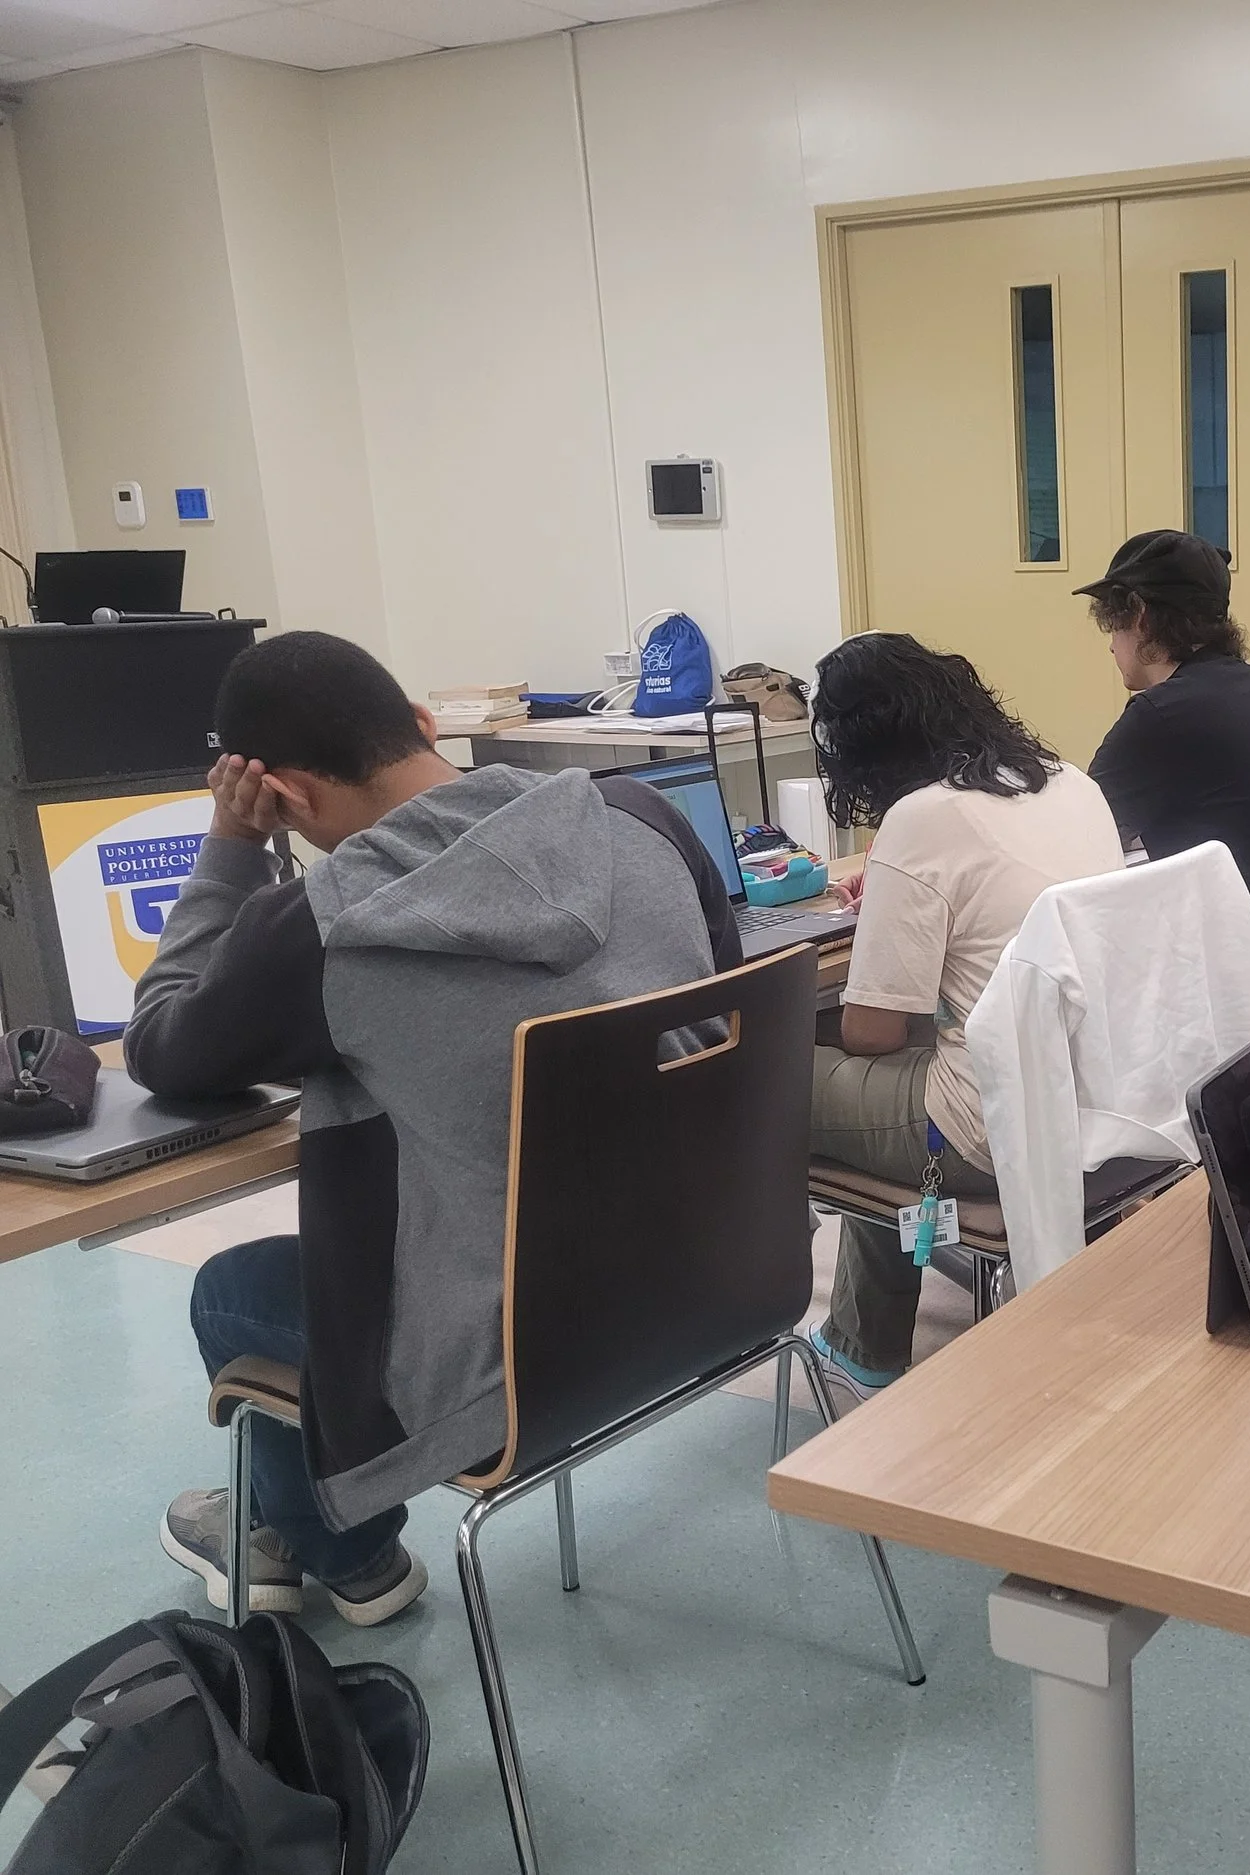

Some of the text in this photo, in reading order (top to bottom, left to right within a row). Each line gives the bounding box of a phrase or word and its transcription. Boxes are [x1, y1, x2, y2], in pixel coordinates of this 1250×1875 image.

[645, 675, 671, 687] sturias
[105, 839, 196, 858] UNIVERSID
[107, 853, 198, 874] POLITÉCNI
[110, 869, 172, 883] PUERTO
